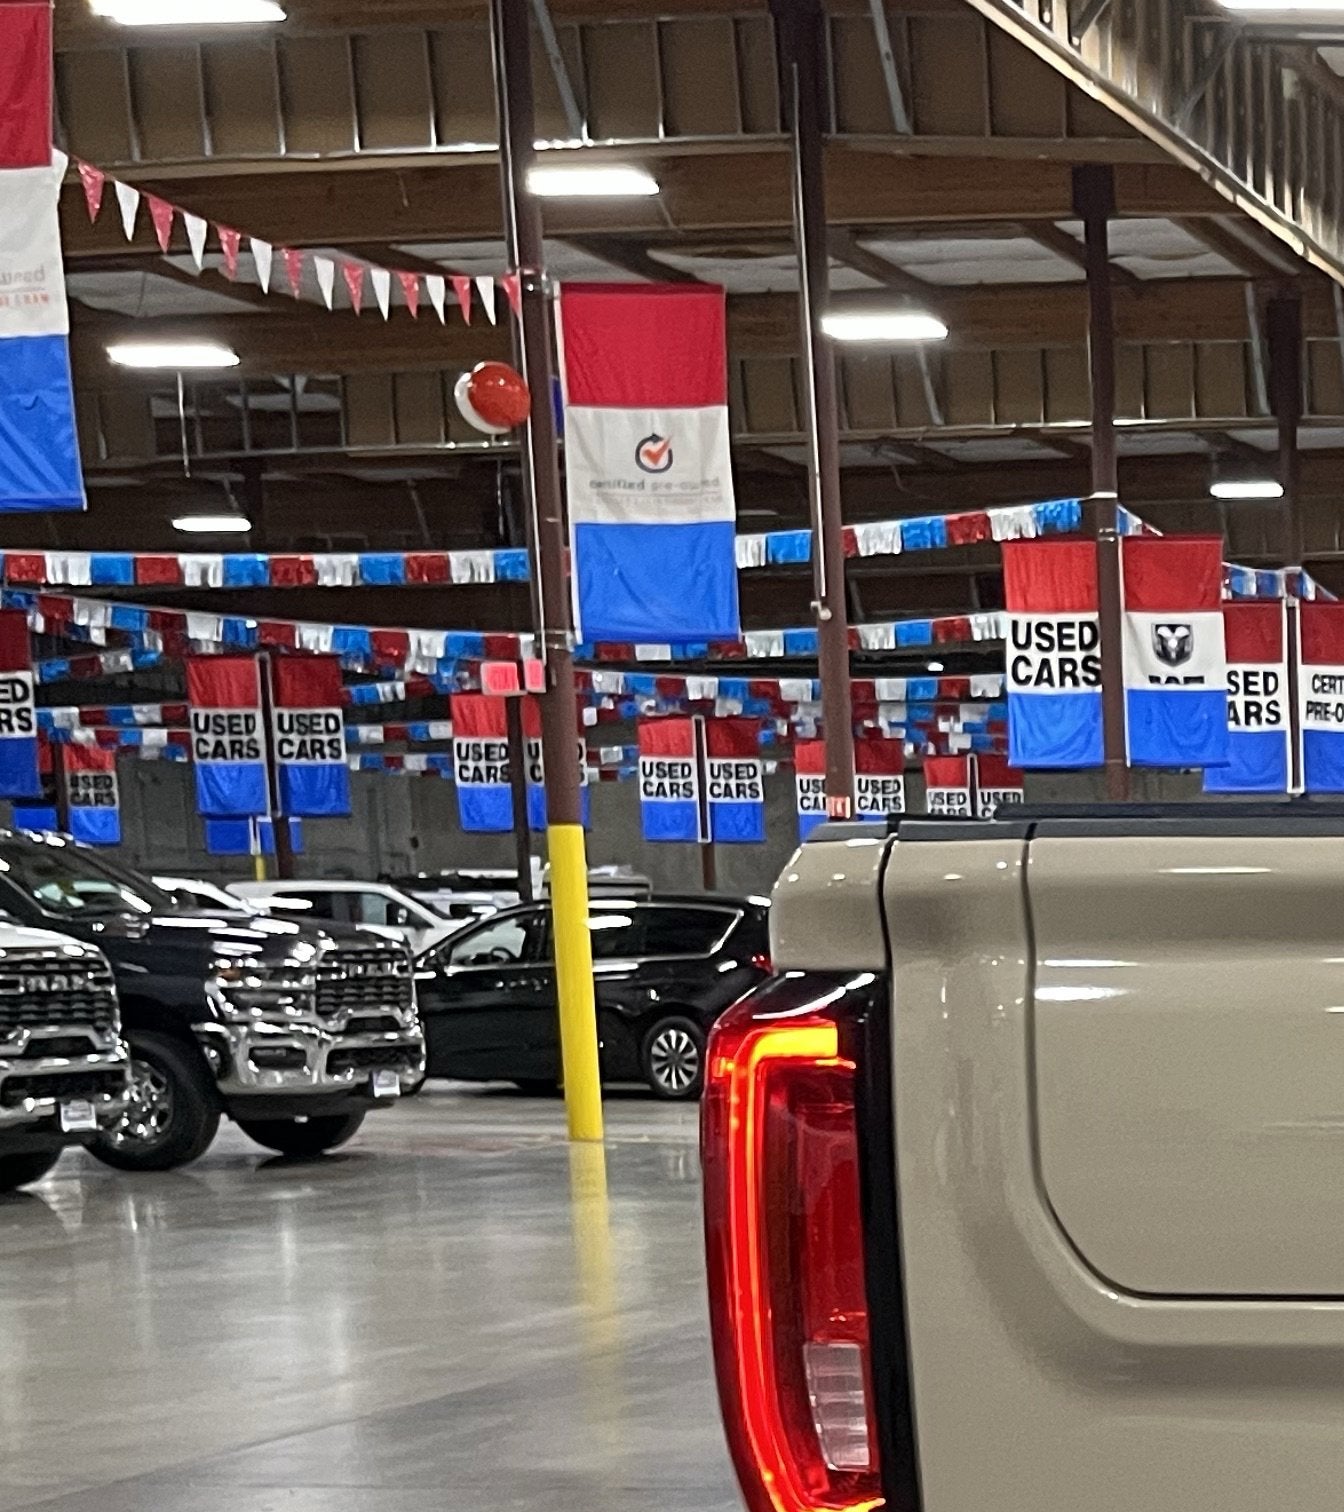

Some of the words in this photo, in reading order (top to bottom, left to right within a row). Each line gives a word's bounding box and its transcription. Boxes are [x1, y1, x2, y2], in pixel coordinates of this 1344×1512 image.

[1012, 620, 1098, 651] USED
[1012, 655, 1101, 687] CARS
[0, 678, 30, 704] ED
[1227, 670, 1279, 696] SED
[0, 707, 33, 733] RS
[1228, 700, 1282, 726] ARS
[193, 713, 256, 735] USED
[277, 713, 341, 735] USED
[195, 738, 260, 760] CARS
[277, 738, 342, 759] CARS
[457, 743, 509, 761] USED
[459, 764, 510, 783] CARS
[642, 761, 692, 779] USED
[710, 763, 757, 779] USED
[643, 781, 694, 798] CARS
[709, 782, 760, 798] CARS
[799, 778, 826, 794] US
[857, 778, 901, 795] USED
[857, 796, 902, 811] CARS
